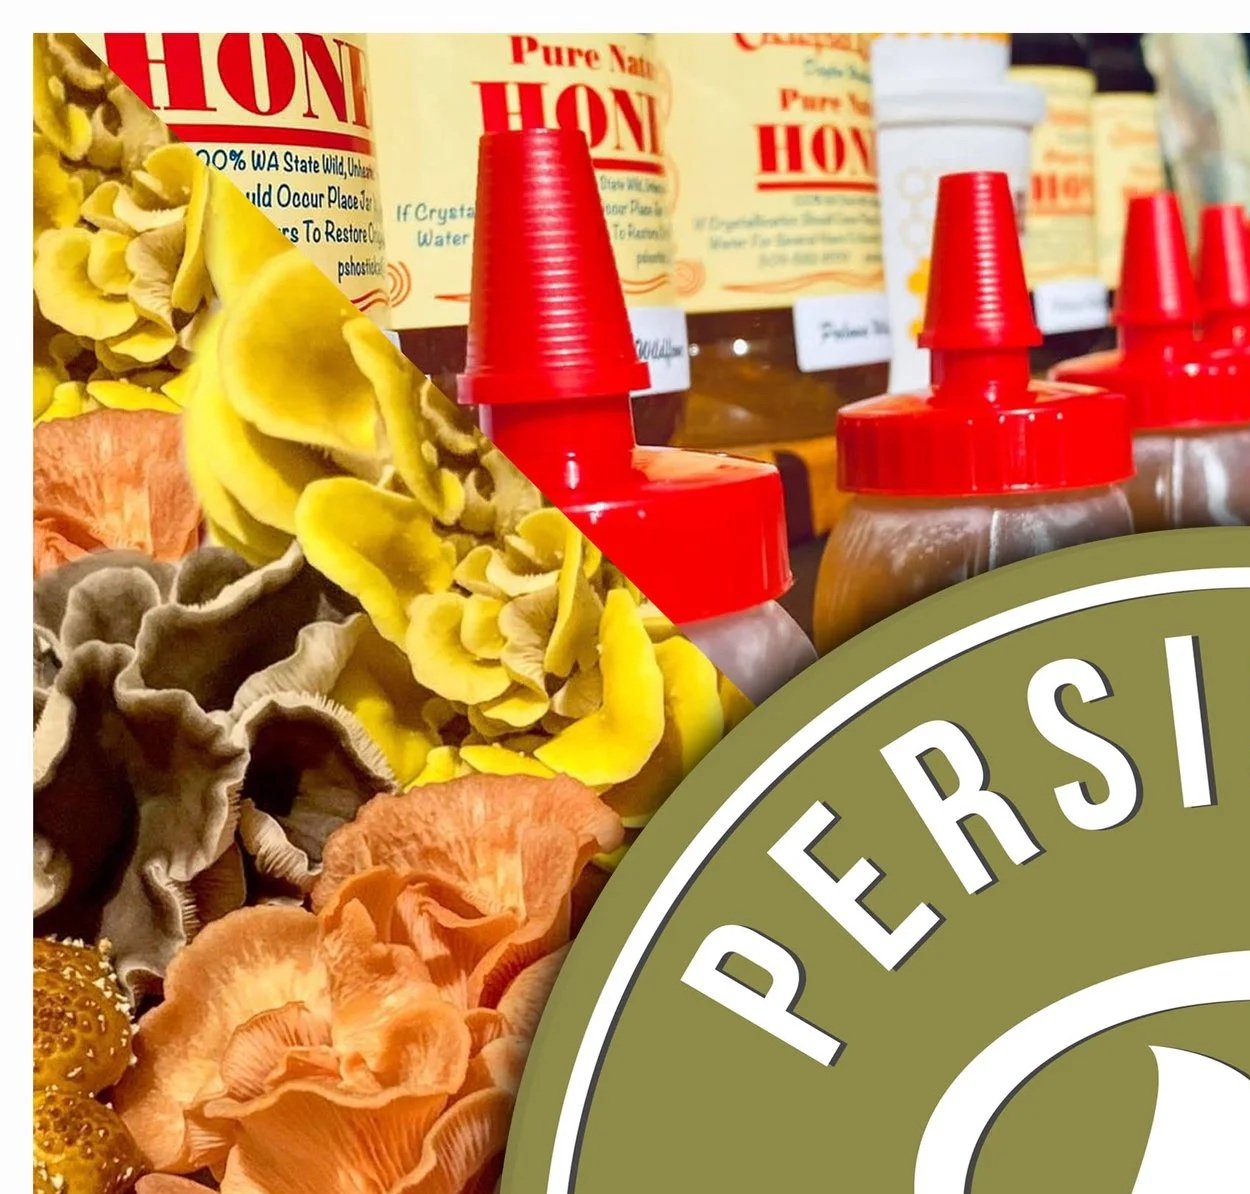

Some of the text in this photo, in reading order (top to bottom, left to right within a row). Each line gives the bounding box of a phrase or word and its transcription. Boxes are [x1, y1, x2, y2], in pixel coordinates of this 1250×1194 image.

[509, 35, 600, 69] Pure
[252, 150, 279, 172] WA
[283, 151, 320, 174] State
[322, 154, 347, 180] Wild,
[277, 183, 324, 209] Occur
[328, 185, 359, 211] Place
[396, 203, 413, 223] If
[303, 219, 321, 244] To
[325, 219, 368, 244] Restore
[417, 234, 470, 248] Water
